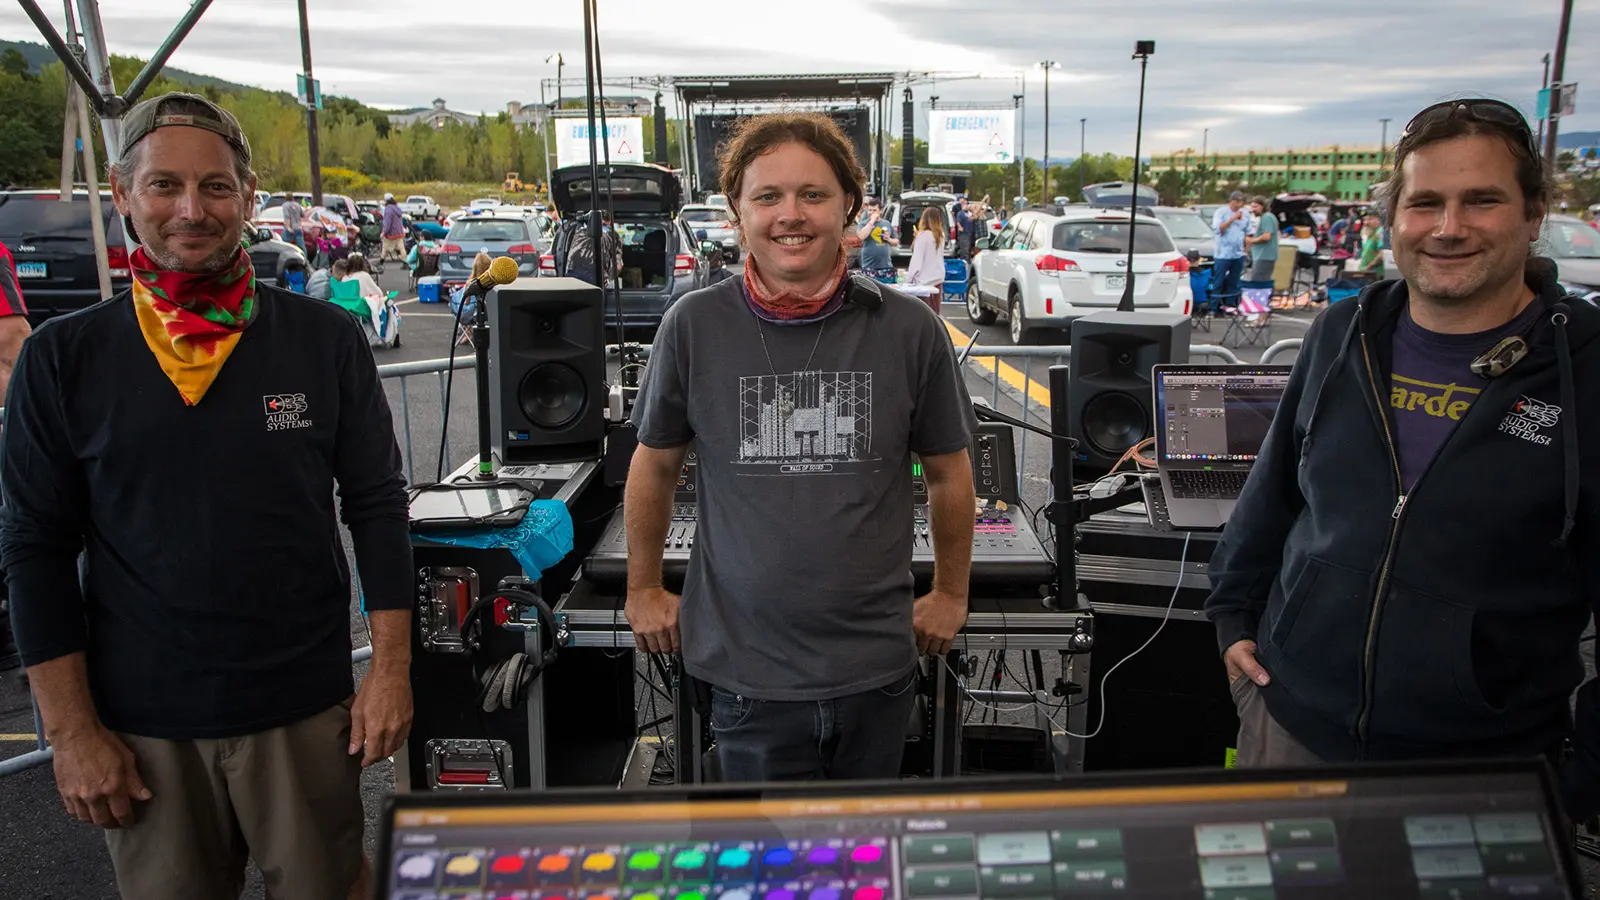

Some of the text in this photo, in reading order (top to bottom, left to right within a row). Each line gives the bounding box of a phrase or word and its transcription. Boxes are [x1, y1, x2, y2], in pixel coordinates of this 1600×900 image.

[18, 244, 36, 252] Jeep
[266, 413, 300, 424] AUDIO
[1502, 415, 1540, 432] AUDIO
[267, 420, 310, 431] SYSTEMS
[1498, 421, 1548, 444] SYSTEMS
